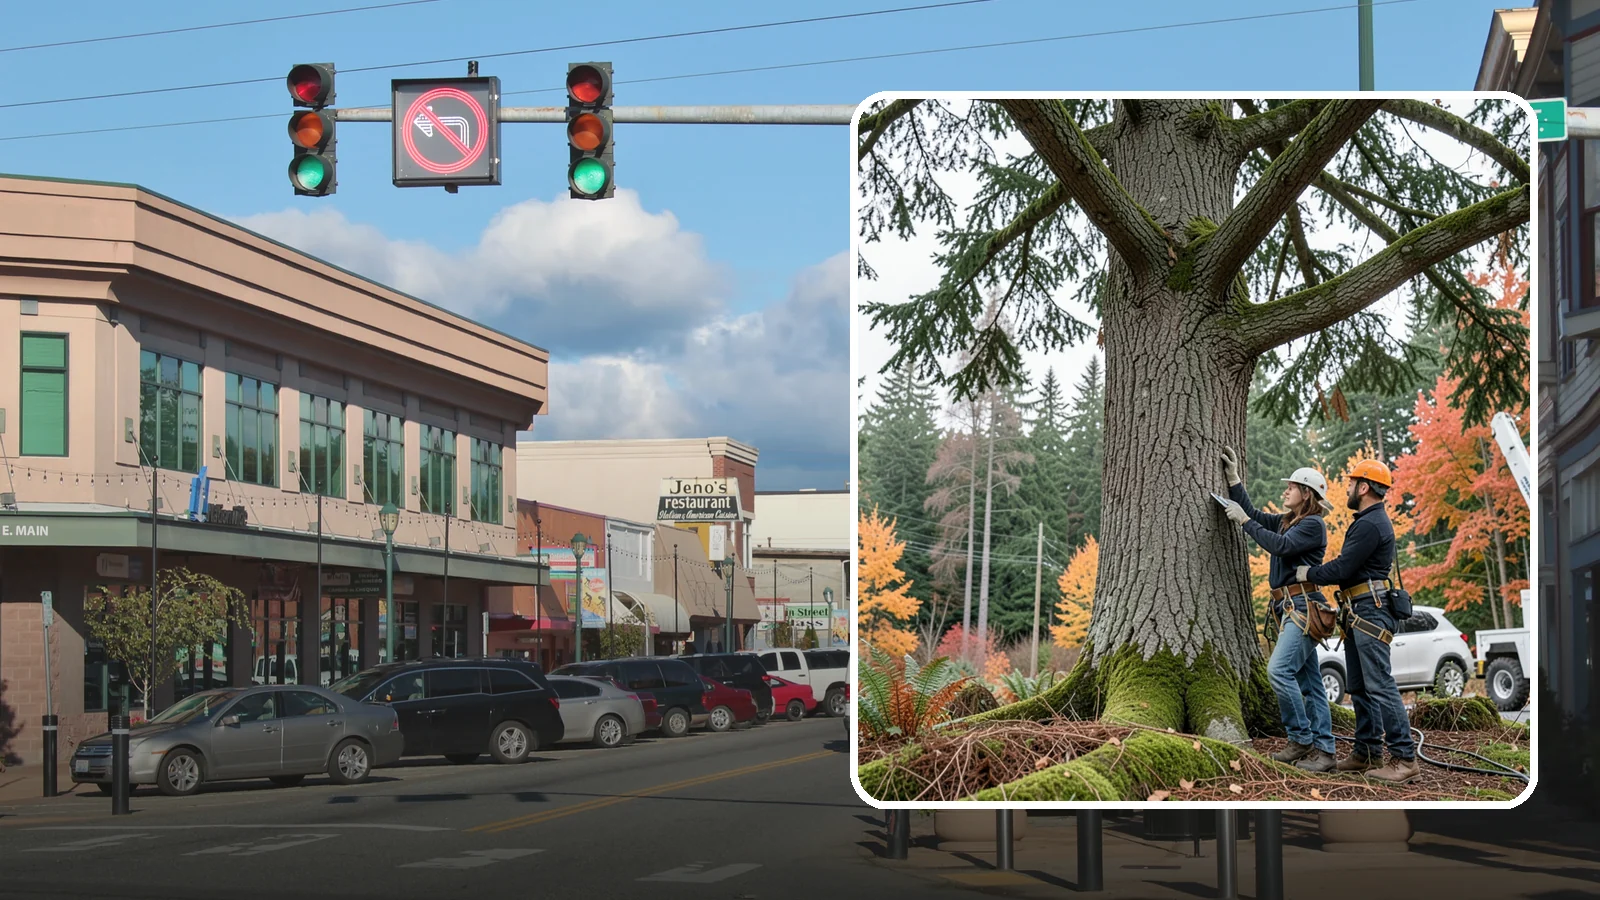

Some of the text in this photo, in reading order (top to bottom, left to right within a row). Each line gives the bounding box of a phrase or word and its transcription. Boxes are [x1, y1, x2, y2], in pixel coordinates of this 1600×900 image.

[669, 480, 727, 494] Jeno's
[665, 496, 731, 509] restaurant
[658, 509, 682, 519] Italian
[686, 509, 714, 519] American
[715, 509, 738, 519] Cuisine
[3, 525, 49, 536] E. MAIN
[797, 607, 828, 616] Street
